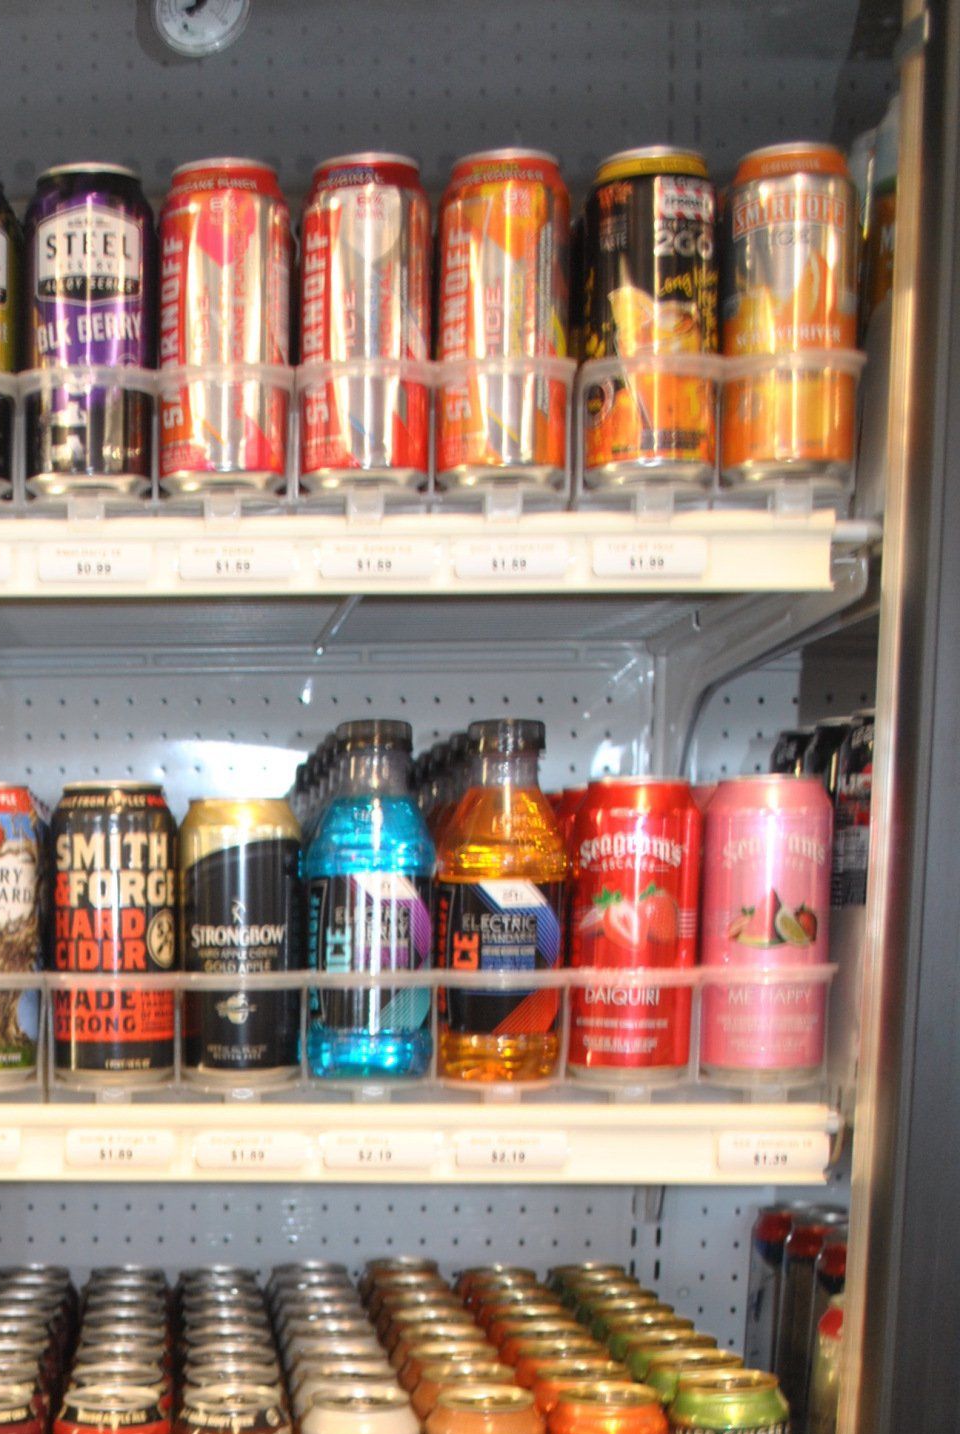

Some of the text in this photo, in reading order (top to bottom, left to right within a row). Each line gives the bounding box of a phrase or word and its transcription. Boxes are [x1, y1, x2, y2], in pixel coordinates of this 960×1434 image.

[734, 196, 845, 228] SMIRNOFF
[46, 231, 131, 261] STEEL
[37, 311, 141, 354] BLK BERRY
[78, 562, 112, 575] $0.99
[56, 833, 168, 870] SMITH
[580, 831, 683, 868] Seagram's
[56, 908, 146, 940] HARD
[191, 924, 286, 947] STRONGBOW
[462, 913, 537, 932] ELECTRIC
[56, 941, 147, 971] CIDER
[56, 988, 138, 1010] MADE
[584, 985, 660, 1006] DAIQUIRI
[56, 1015, 137, 1034] STRONG
[492, 1150, 525, 1162] $2.19
